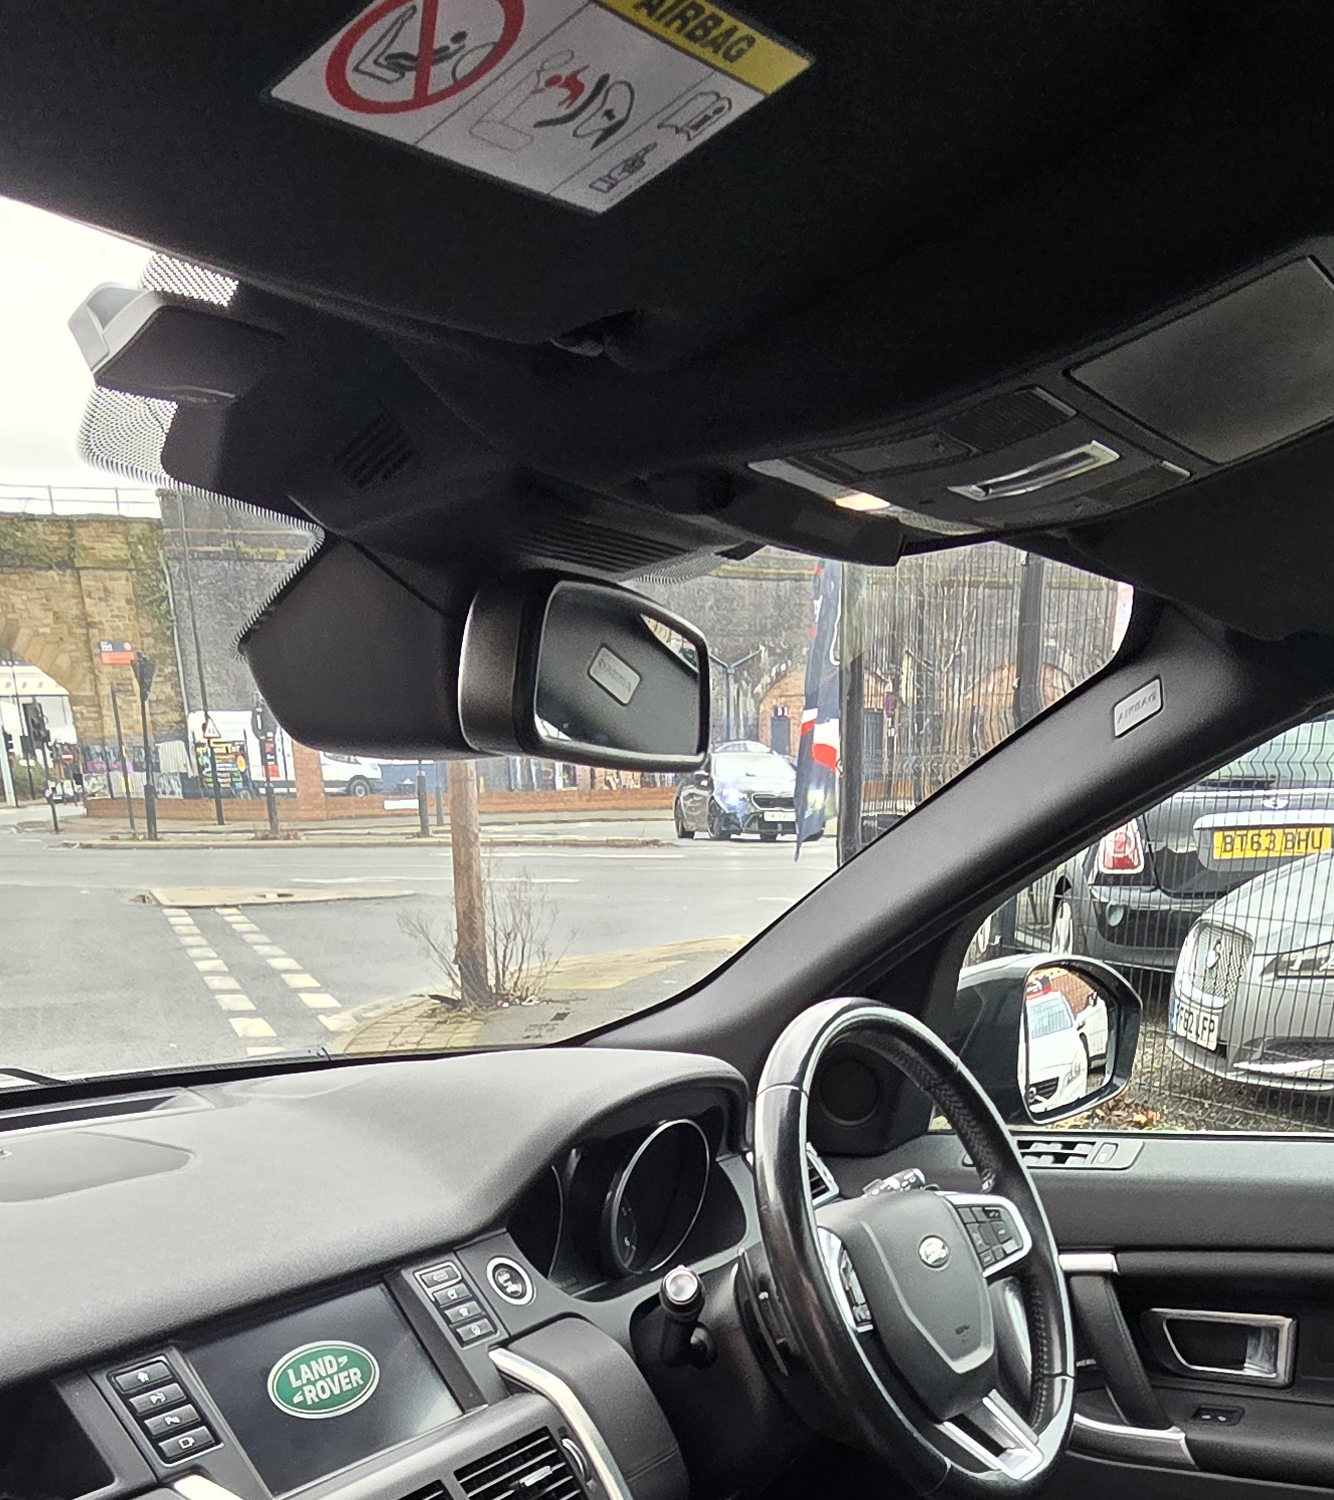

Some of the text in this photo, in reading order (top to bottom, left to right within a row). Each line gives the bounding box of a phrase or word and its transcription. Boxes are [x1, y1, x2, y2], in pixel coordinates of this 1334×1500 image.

[633, 0, 756, 63] AIRBAG
[1222, 827, 1323, 853] BT63 BHU
[287, 1355, 338, 1388] LAND
[303, 1367, 364, 1405] ROVER
